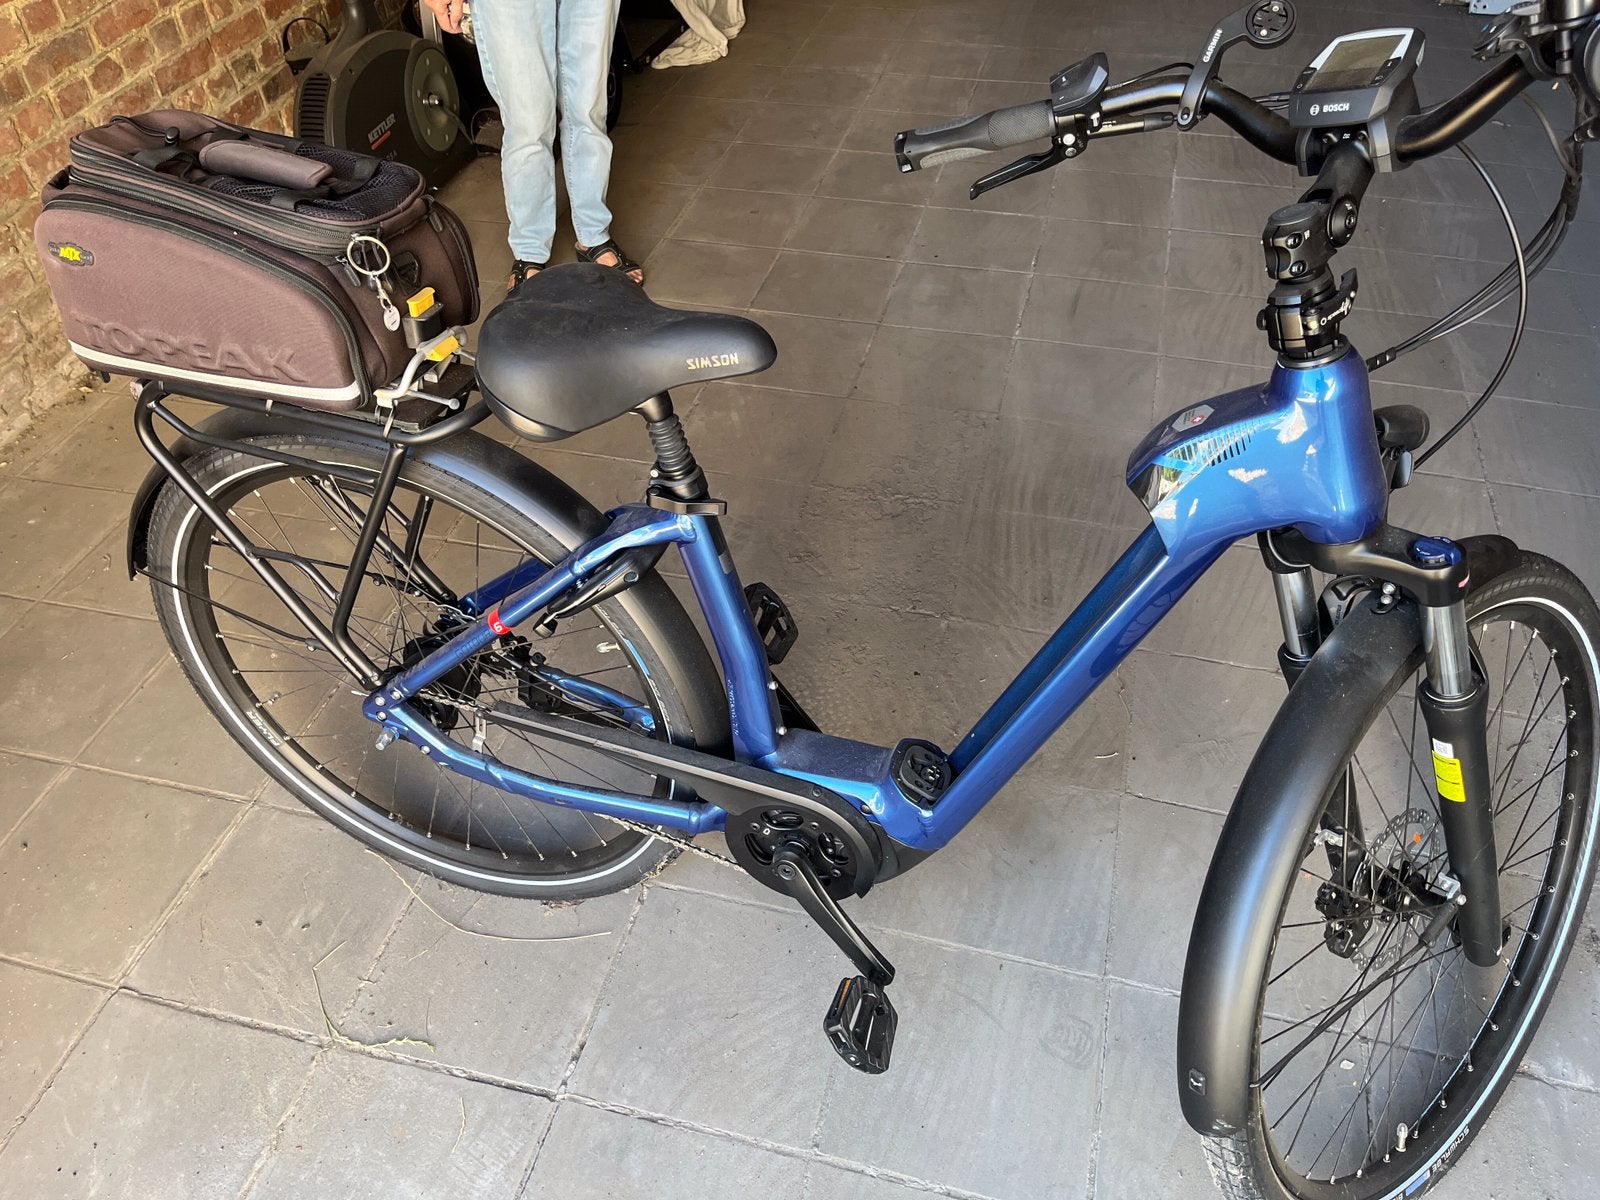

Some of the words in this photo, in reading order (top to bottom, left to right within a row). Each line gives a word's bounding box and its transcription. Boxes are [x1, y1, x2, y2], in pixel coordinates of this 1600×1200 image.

[1203, 28, 1223, 62] GARMIN
[1322, 102, 1350, 113] BOSCH
[367, 113, 396, 144] KETTLER
[686, 351, 739, 370] SIMSON
[1431, 1125, 1470, 1173] SCHWALBE
